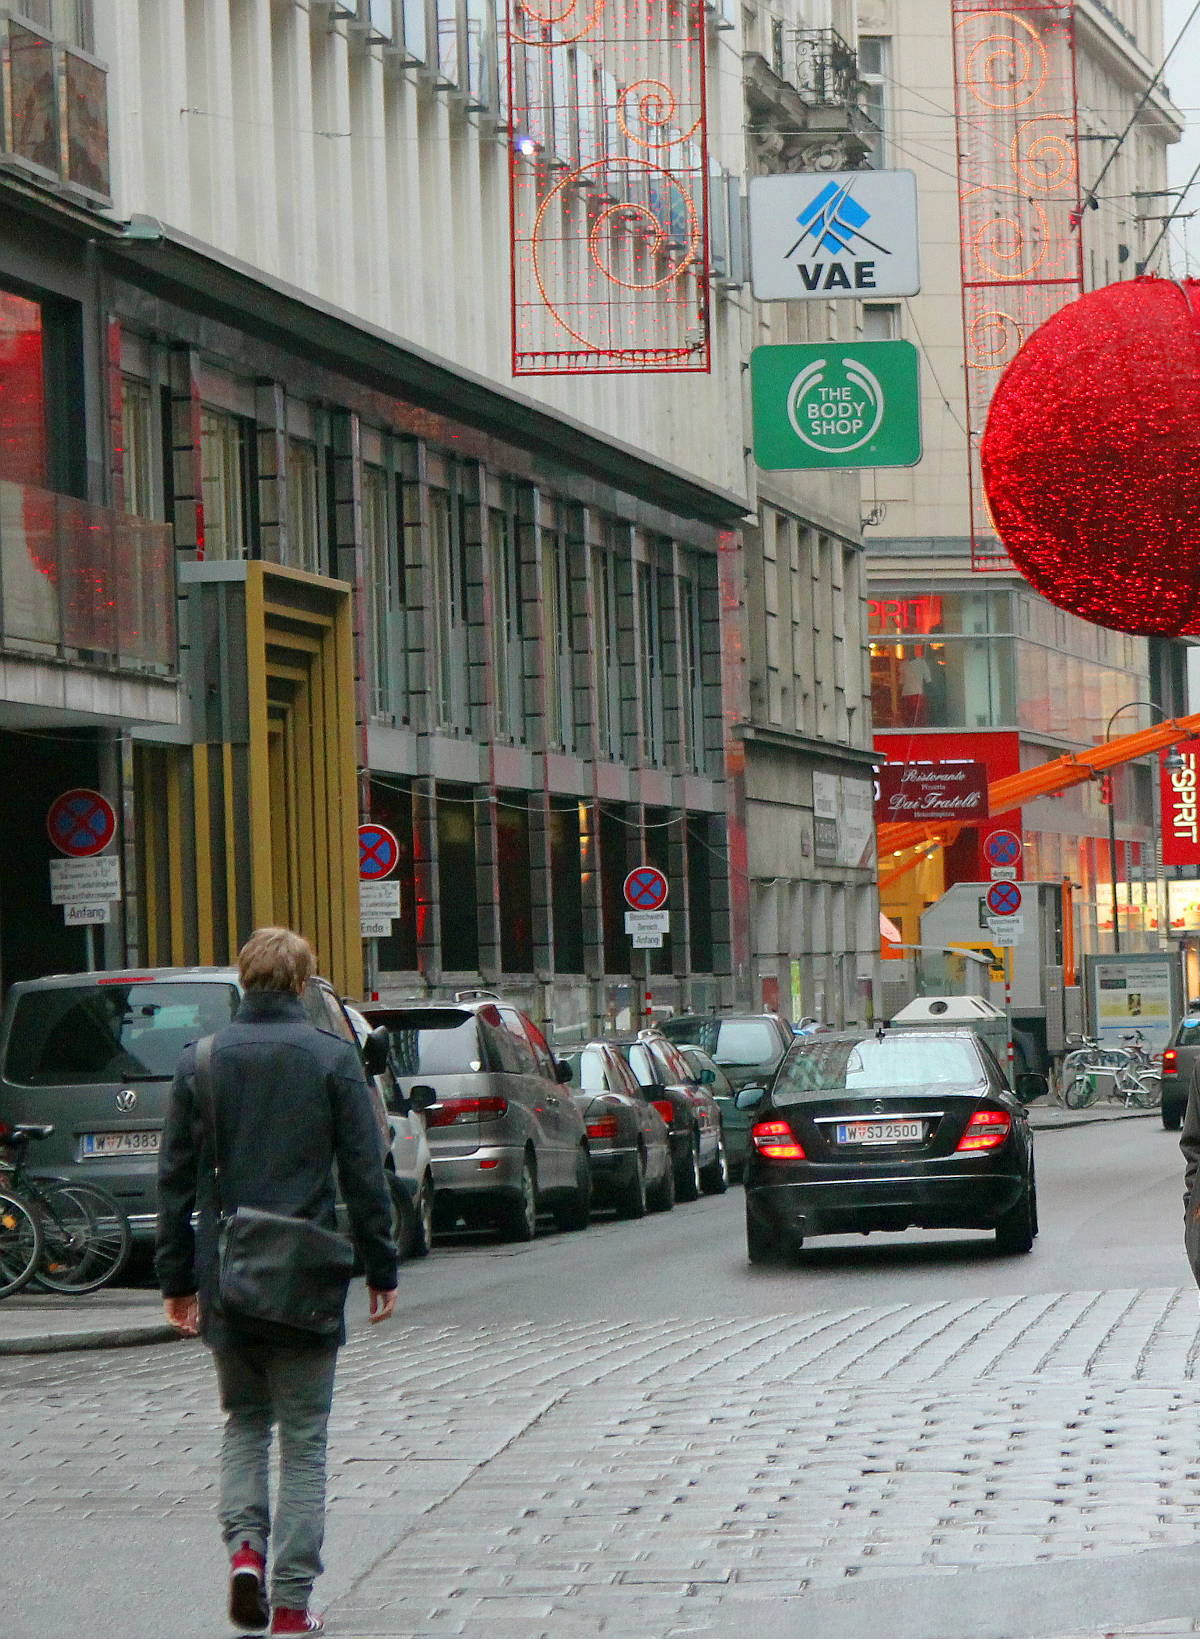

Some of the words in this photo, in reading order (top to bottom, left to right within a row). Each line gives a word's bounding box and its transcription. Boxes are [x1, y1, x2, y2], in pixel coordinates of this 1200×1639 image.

[797, 261, 877, 291] VAE
[818, 387, 852, 401] THE
[807, 402, 865, 420] BODY
[811, 419, 864, 436] SHOP
[901, 769, 966, 783] Ristorante
[888, 793, 919, 810] Dai
[920, 791, 981, 810] Fratelli
[1171, 752, 1198, 844] ESPRIT
[69, 907, 105, 921] Anfang
[361, 922, 384, 934] Ende
[847, 1127, 857, 1140] W
[867, 1126, 883, 1139] SJ
[886, 1124, 918, 1138] 2500
[95, 1137, 106, 1150] W
[116, 1134, 158, 1149] 74383
